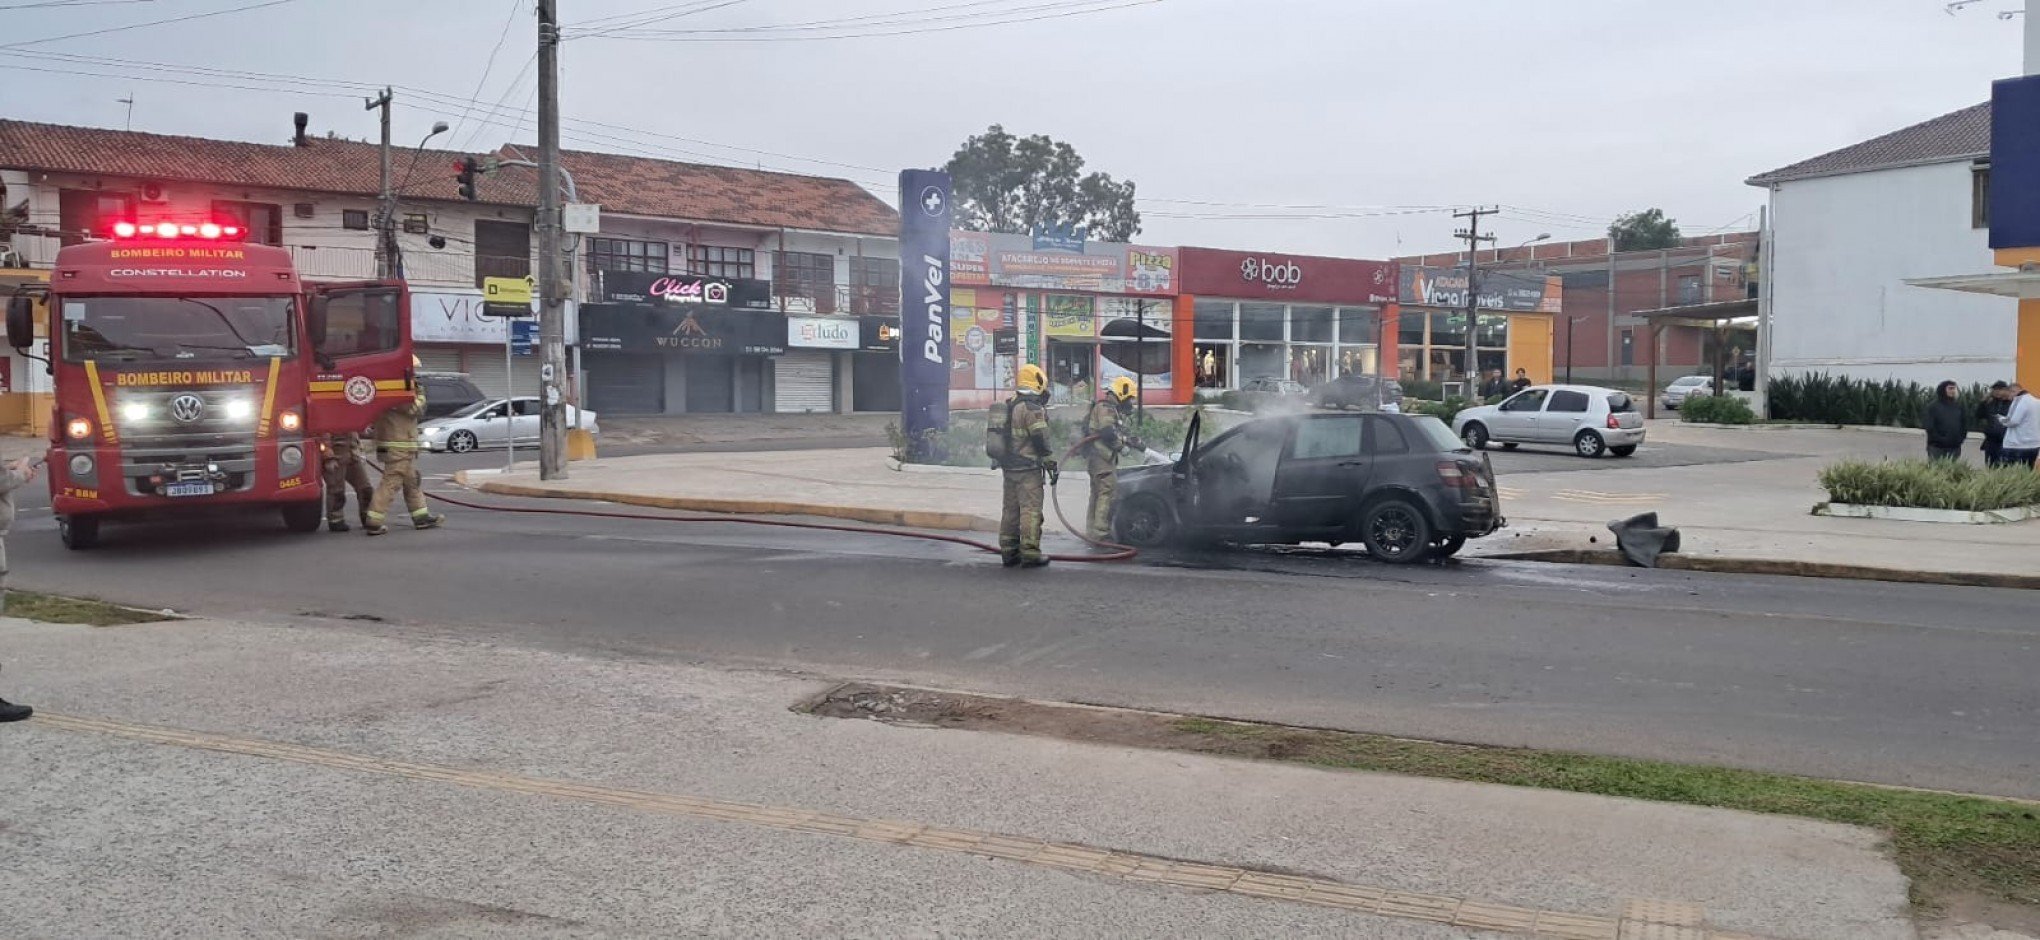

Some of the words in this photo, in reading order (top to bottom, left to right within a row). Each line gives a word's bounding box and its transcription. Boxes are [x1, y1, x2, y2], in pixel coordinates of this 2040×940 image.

[111, 249, 185, 258] BOMBEIRO
[189, 249, 244, 259] MILITAR
[110, 269, 246, 277] CONSTELLATION
[1261, 258, 1301, 284] bob
[649, 278, 702, 295] Click
[117, 370, 192, 386] BOMBEIRO
[196, 370, 251, 384] MILITAR
